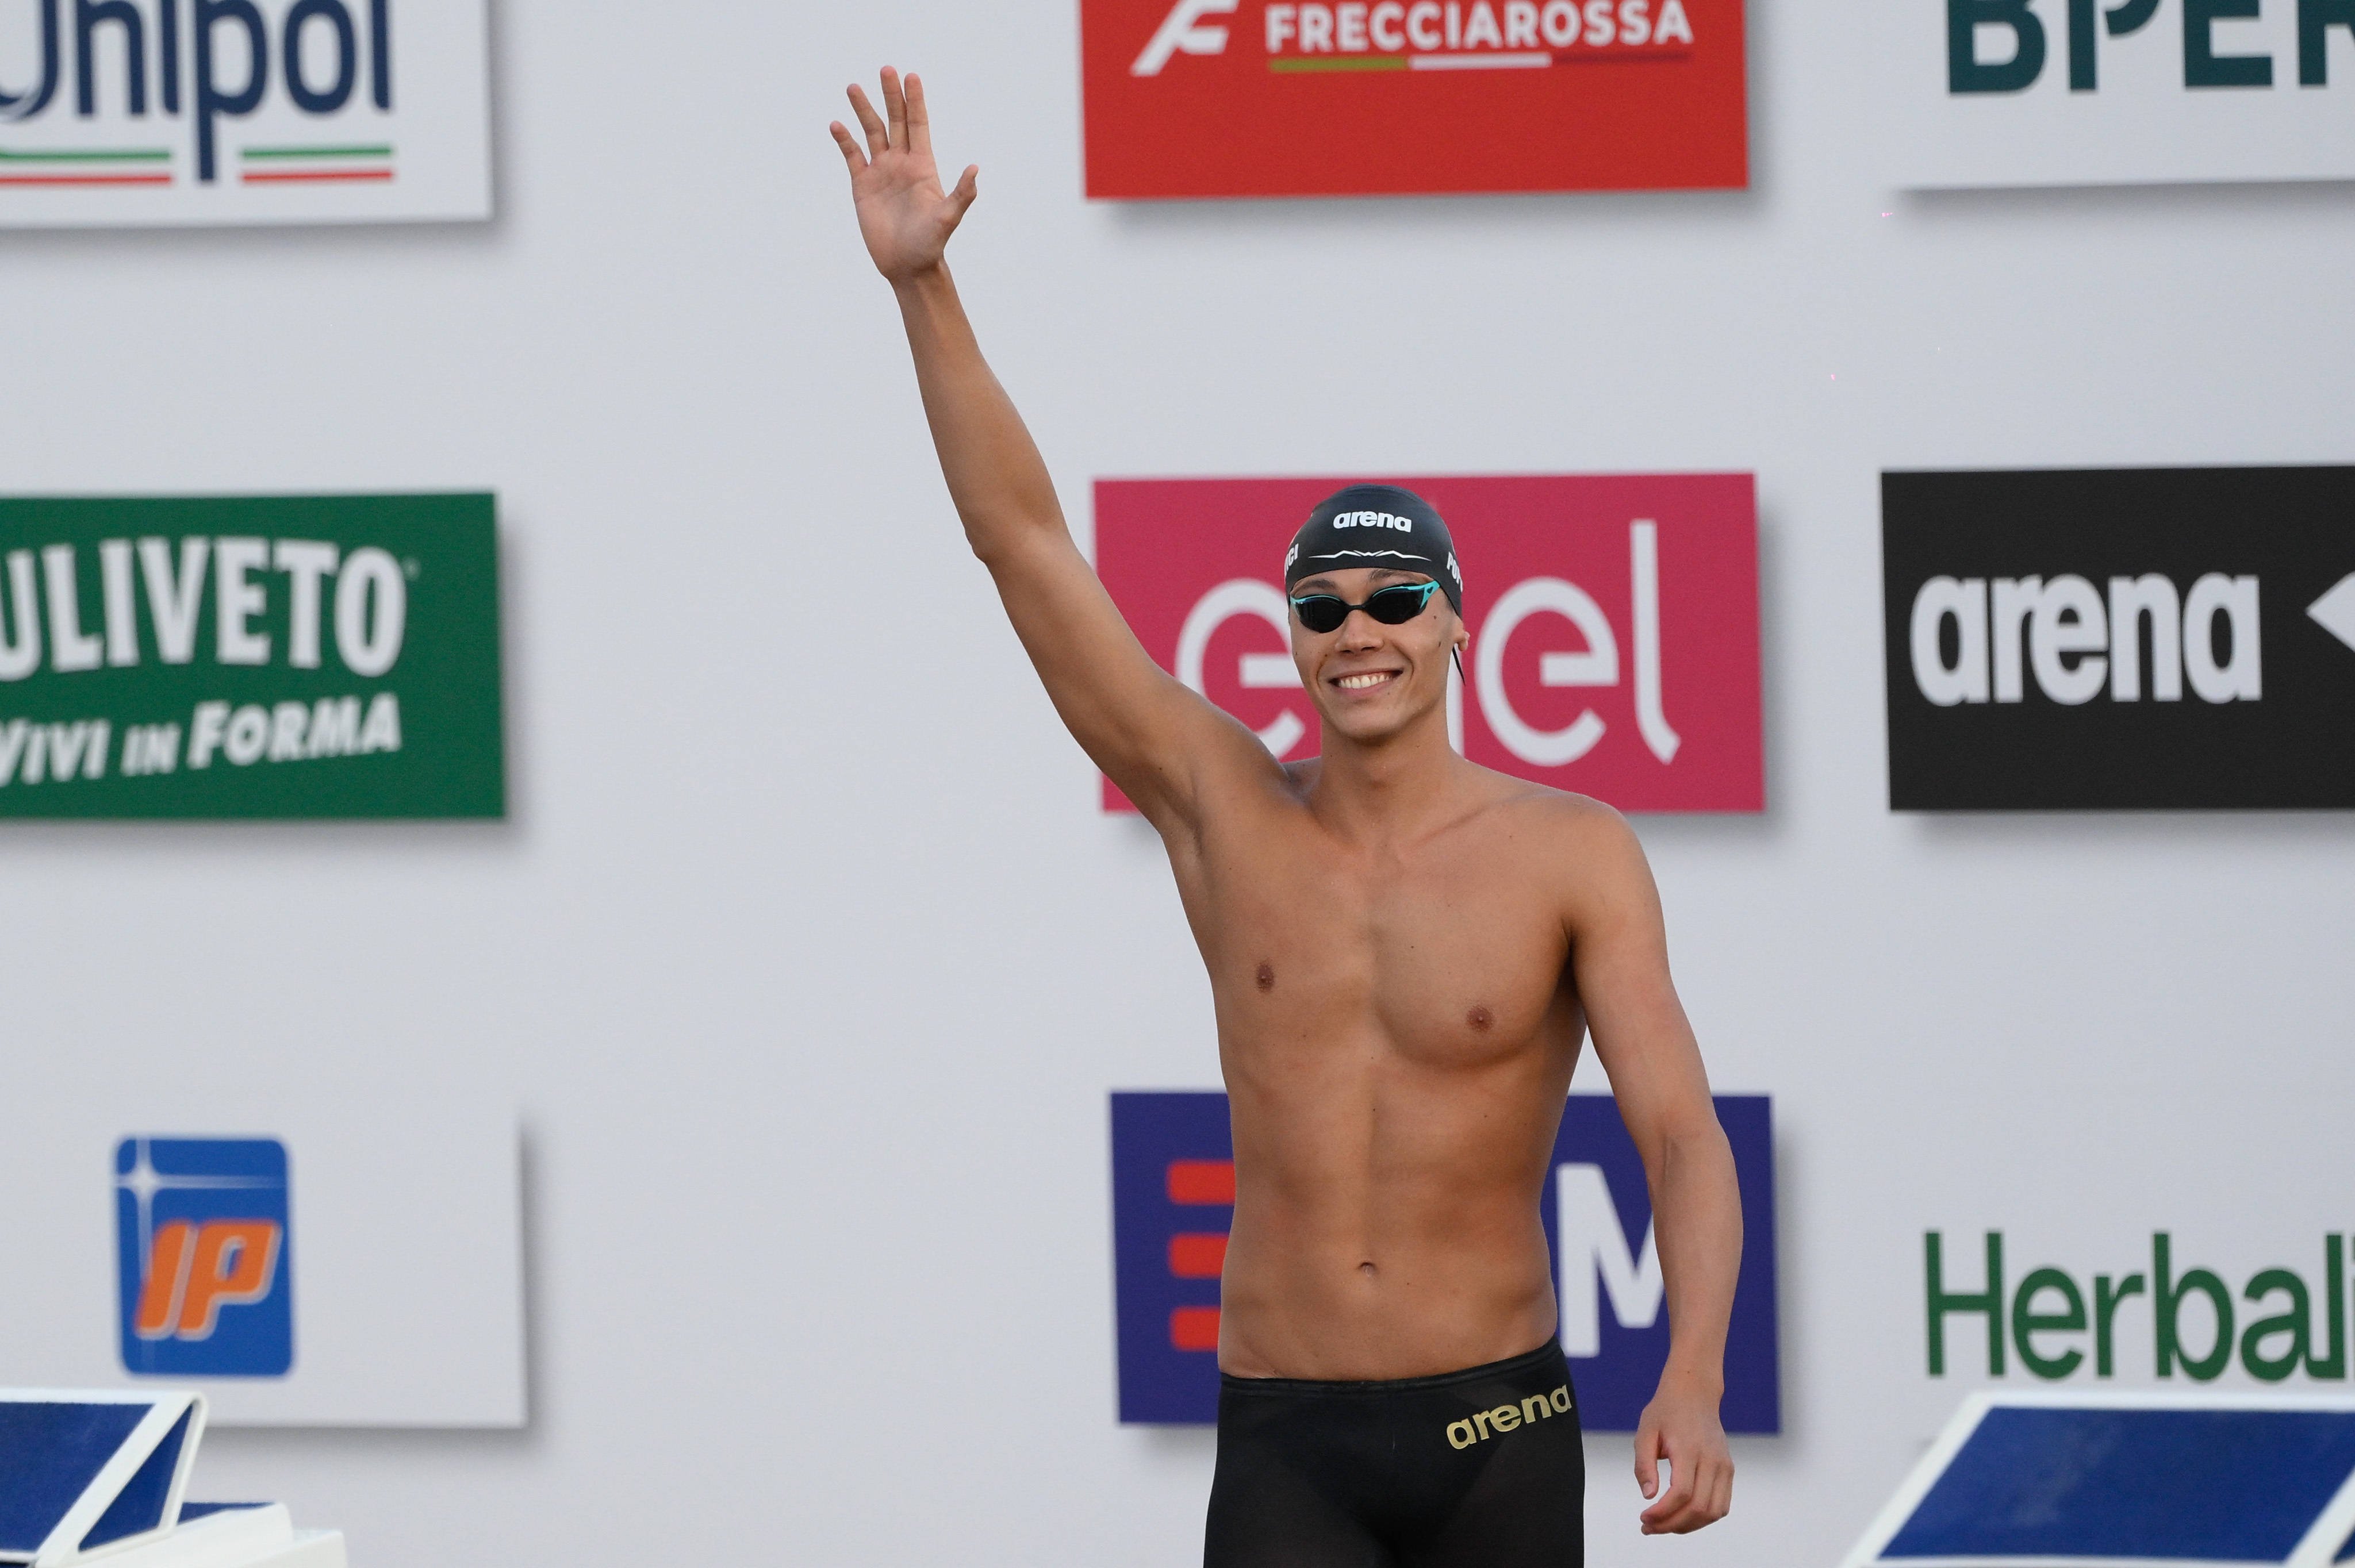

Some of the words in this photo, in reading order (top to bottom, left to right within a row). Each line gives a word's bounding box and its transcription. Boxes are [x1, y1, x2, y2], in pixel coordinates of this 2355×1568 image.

[1264, 0, 1694, 53] FRECCIAROSSA
[1333, 510, 1412, 533] arena
[1175, 519, 1680, 767] eel
[1909, 572, 2263, 707] arena
[120, 722, 182, 777] IN
[186, 692, 402, 770] FORMA
[135, 1219, 282, 1340] IP
[1924, 1231, 2355, 1384] Herbal
[1445, 1384, 1572, 1450] arena
